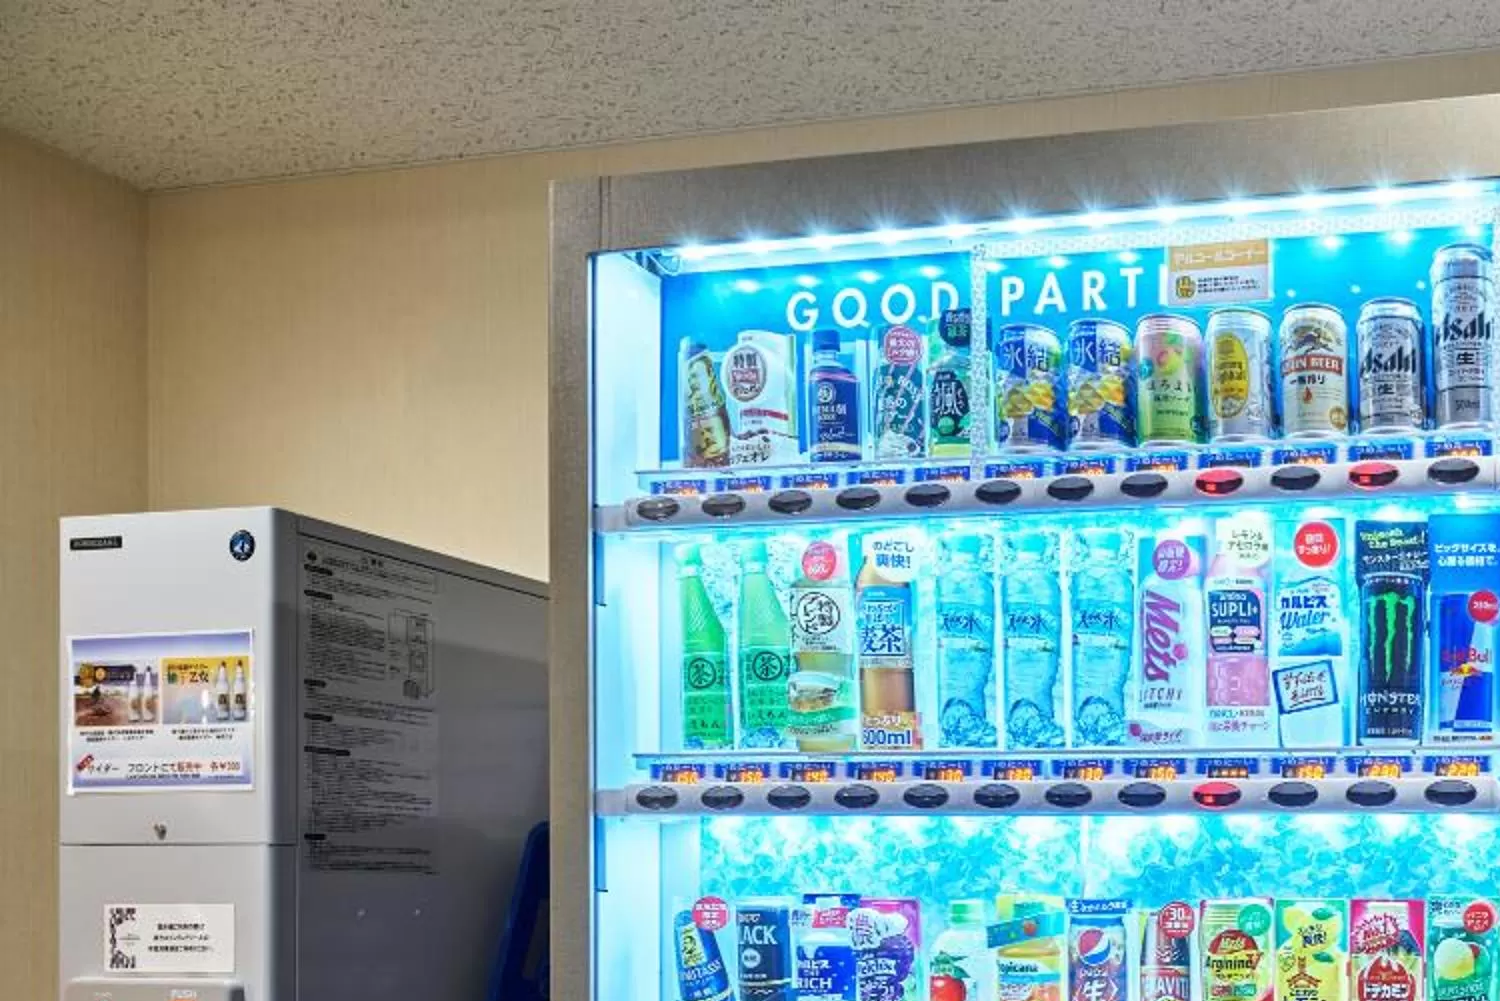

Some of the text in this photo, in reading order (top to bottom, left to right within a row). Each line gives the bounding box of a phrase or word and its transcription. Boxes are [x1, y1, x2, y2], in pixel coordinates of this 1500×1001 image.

[1000, 263, 1168, 316] PART
[1435, 311, 1495, 346] Asahi
[1004, 343, 1050, 373] 氷結
[1072, 337, 1121, 367] 氷結
[1360, 346, 1417, 378] Asahi
[1456, 351, 1476, 365] 生
[872, 540, 914, 553] のどごし
[875, 553, 911, 569] 爽快!
[1143, 589, 1183, 683] Mets
[1280, 610, 1332, 632] Water
[1363, 983, 1411, 998] ドデカミン
